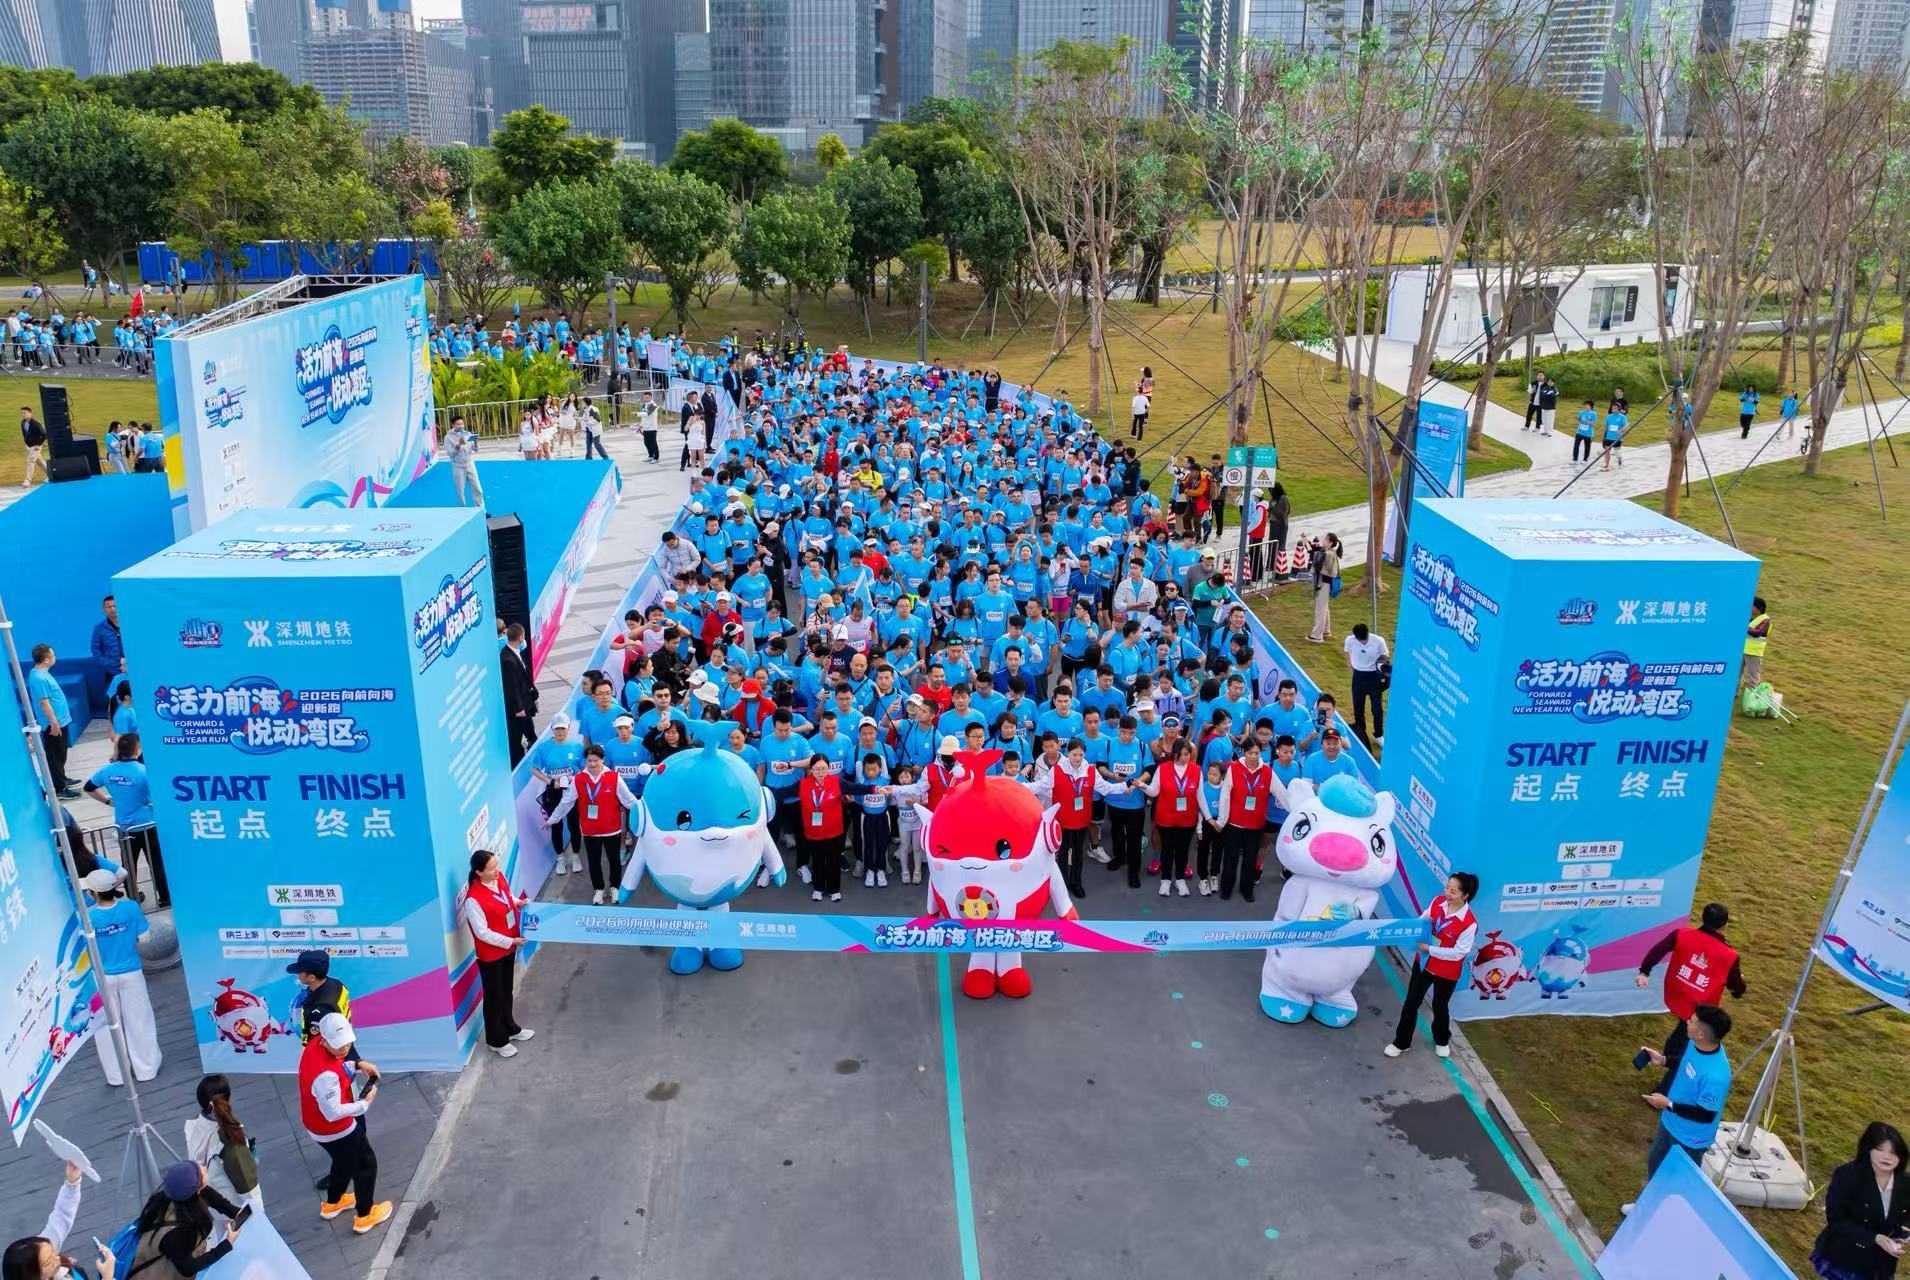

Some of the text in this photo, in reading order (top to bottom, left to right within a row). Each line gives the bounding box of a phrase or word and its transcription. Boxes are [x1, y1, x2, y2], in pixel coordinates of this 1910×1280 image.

[301, 337, 343, 385] 活力前海
[332, 365, 369, 413] 悦动湾区
[1416, 547, 1455, 595] 活力前海
[419, 583, 455, 639] 活力前海
[445, 594, 480, 648] 悦动湾区
[1435, 590, 1478, 645] 悦动湾区
[1643, 601, 1709, 616] 深圳地铁
[276, 621, 352, 638] 深圳地铁
[1529, 660, 1630, 687] 活力前海
[1642, 676, 1677, 686] 迎新跑
[1644, 664, 1726, 674] 2026向前向海
[170, 687, 281, 716] 活力前海
[300, 689, 394, 701] 2026向前向海
[301, 703, 341, 714] 迎新跑
[1588, 689, 1685, 716] 悦动湾区
[247, 717, 355, 747] 悦动湾区
[1506, 739, 1709, 767] START FINISH
[1114, 764, 1135, 772] A0270
[172, 773, 406, 802] START FINISH
[1510, 770, 1689, 802] 起点 终点
[189, 808, 396, 840] 起点 终点
[1578, 844, 1617, 854] 深圳地铁
[292, 888, 337, 898] 深圳地铁
[886, 925, 1055, 949] 活力前海 悦动湾区
[1678, 964, 1710, 987] 摄影
